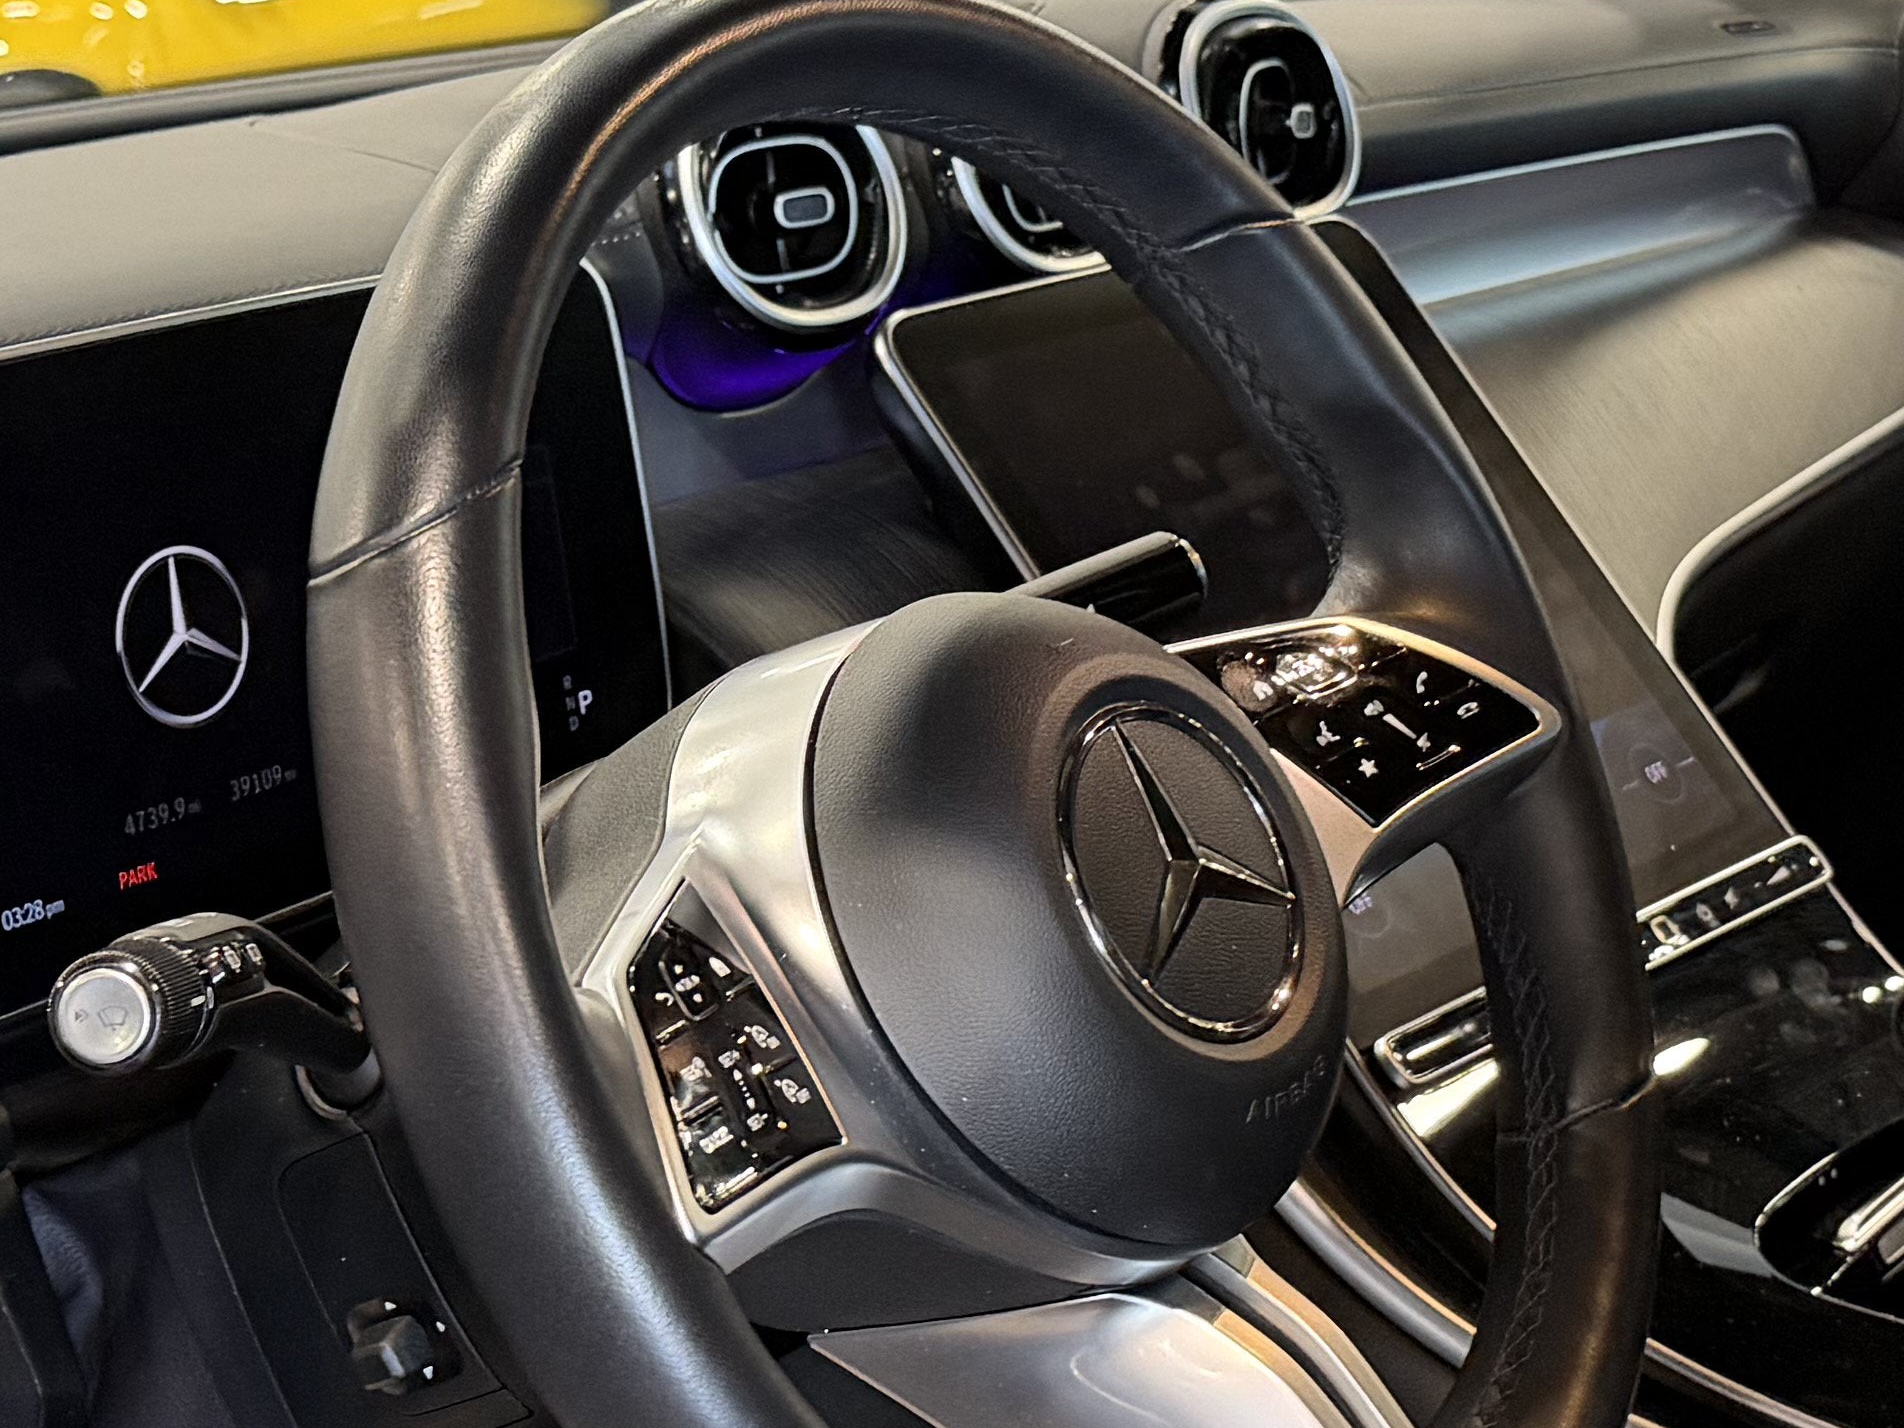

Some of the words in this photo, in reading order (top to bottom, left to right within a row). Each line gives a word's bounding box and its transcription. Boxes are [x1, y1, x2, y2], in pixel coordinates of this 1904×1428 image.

[578, 689, 593, 715] P
[229, 764, 282, 802] 39109
[124, 796, 185, 835] 4739.9
[118, 861, 159, 891] PARK
